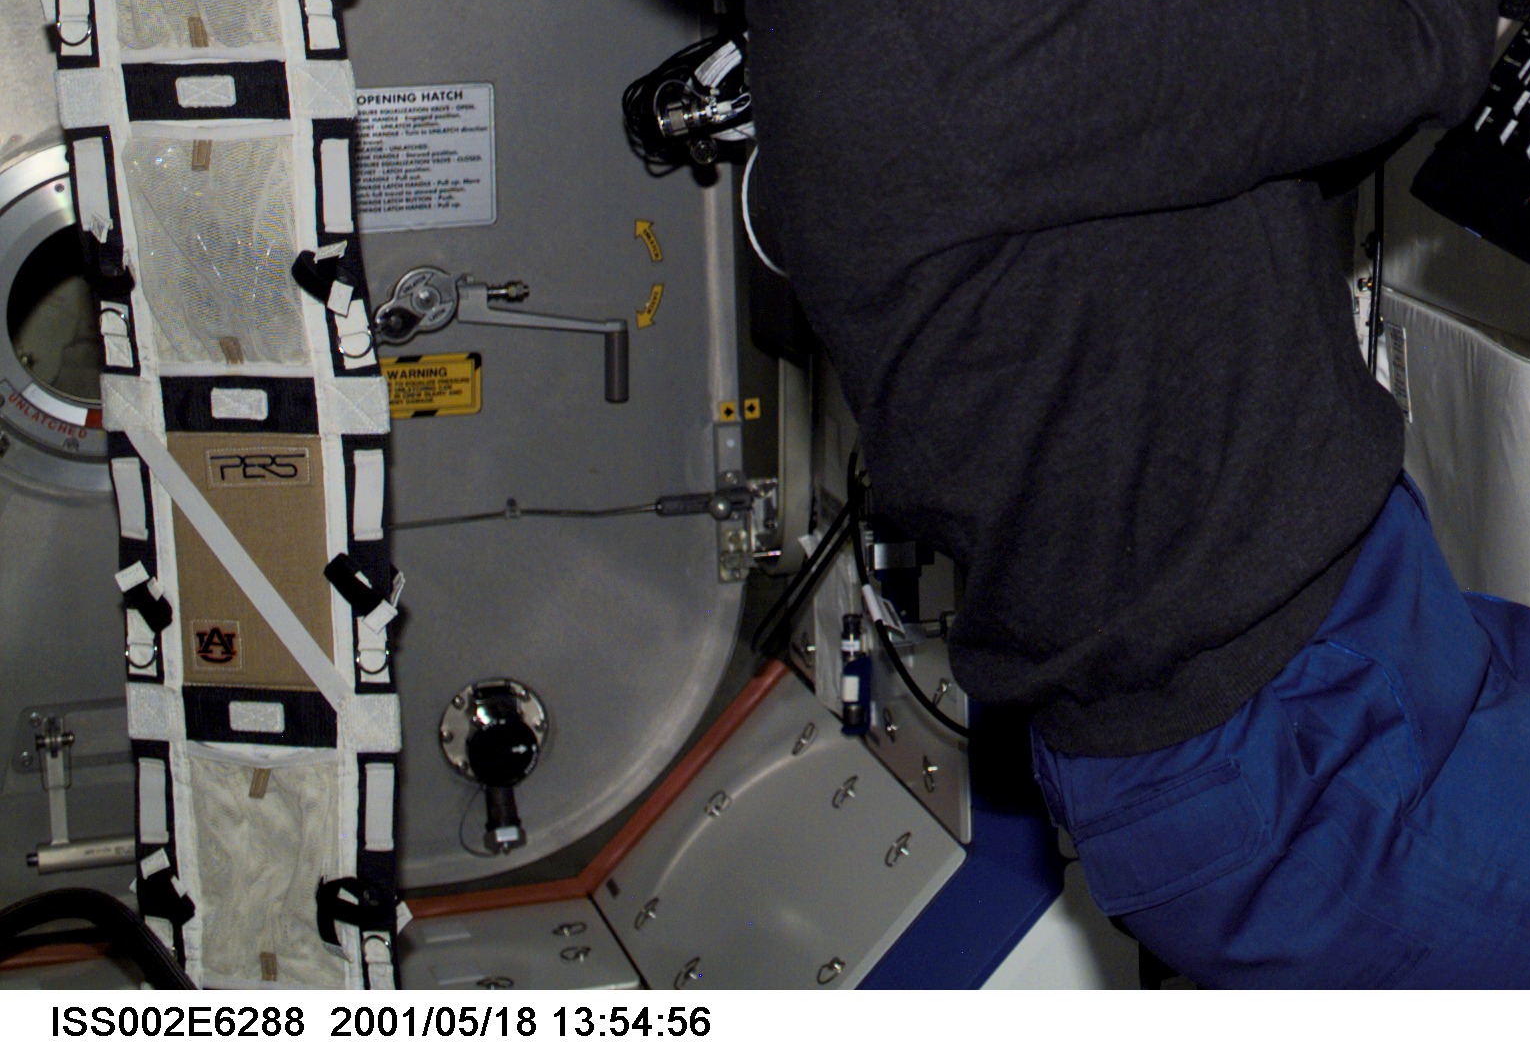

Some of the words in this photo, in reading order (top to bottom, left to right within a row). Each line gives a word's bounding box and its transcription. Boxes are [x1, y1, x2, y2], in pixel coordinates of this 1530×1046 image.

[357, 93, 416, 105] OPENING
[421, 90, 463, 101] HATCH
[387, 367, 447, 379] WARNING
[8, 394, 88, 439] UNLATCHED
[210, 454, 305, 480] PERS
